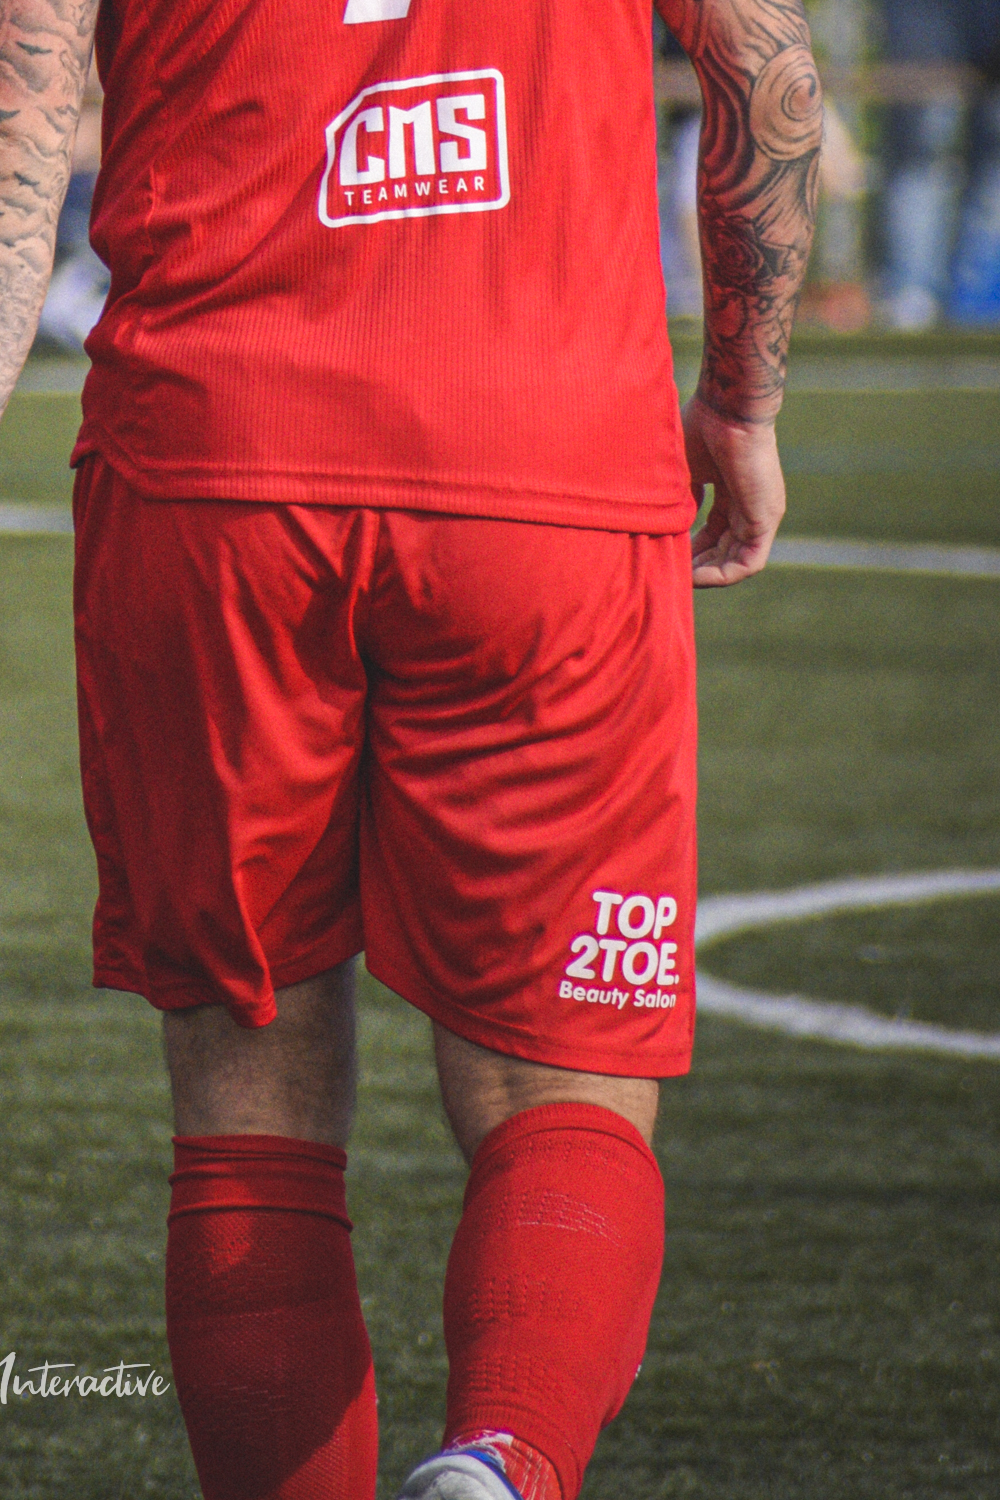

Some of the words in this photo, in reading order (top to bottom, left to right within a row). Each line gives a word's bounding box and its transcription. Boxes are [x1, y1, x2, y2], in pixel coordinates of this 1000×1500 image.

[339, 93, 487, 186] CMS
[343, 176, 485, 206] TEAMWEAR
[592, 891, 678, 940] TOP
[558, 980, 629, 1010] Beauty
[633, 989, 677, 1009] Salon
